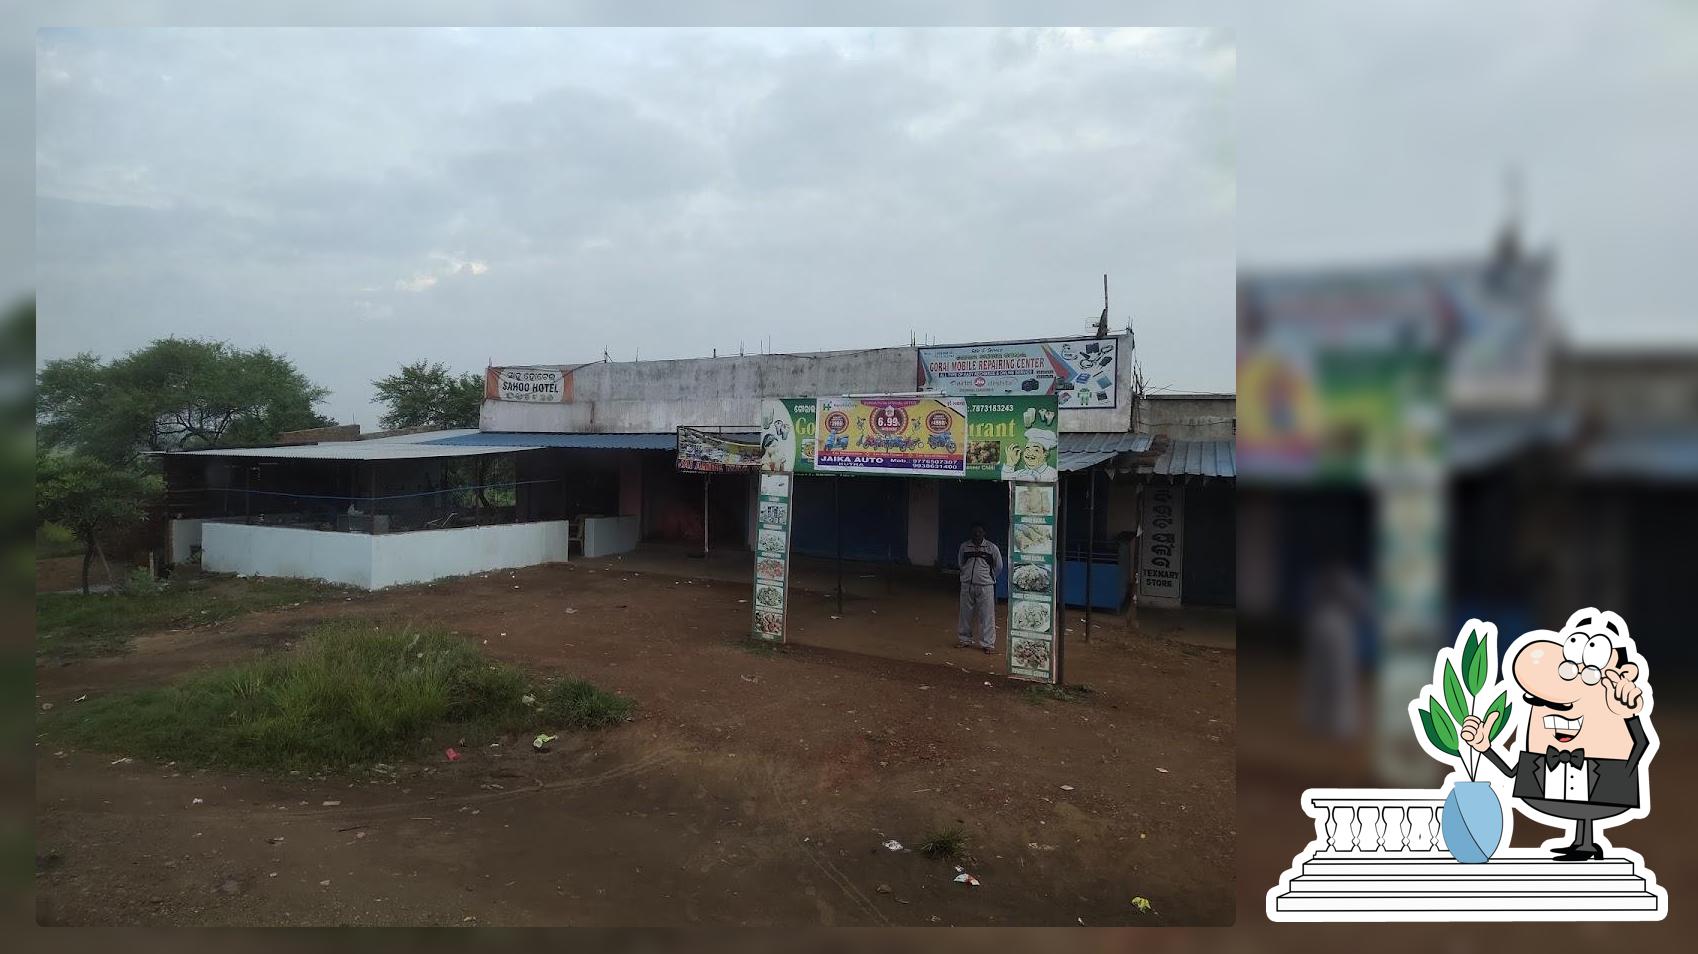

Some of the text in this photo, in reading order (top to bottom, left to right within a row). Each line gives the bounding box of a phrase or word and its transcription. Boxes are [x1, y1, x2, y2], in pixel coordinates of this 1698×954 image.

[951, 360, 976, 371] MOBILE
[978, 359, 1015, 370] REPAIRING
[1016, 357, 1045, 369] CENTER
[502, 381, 559, 393] SAHOO HOTEL
[796, 417, 816, 436] Go
[1146, 579, 1172, 587] STORE
